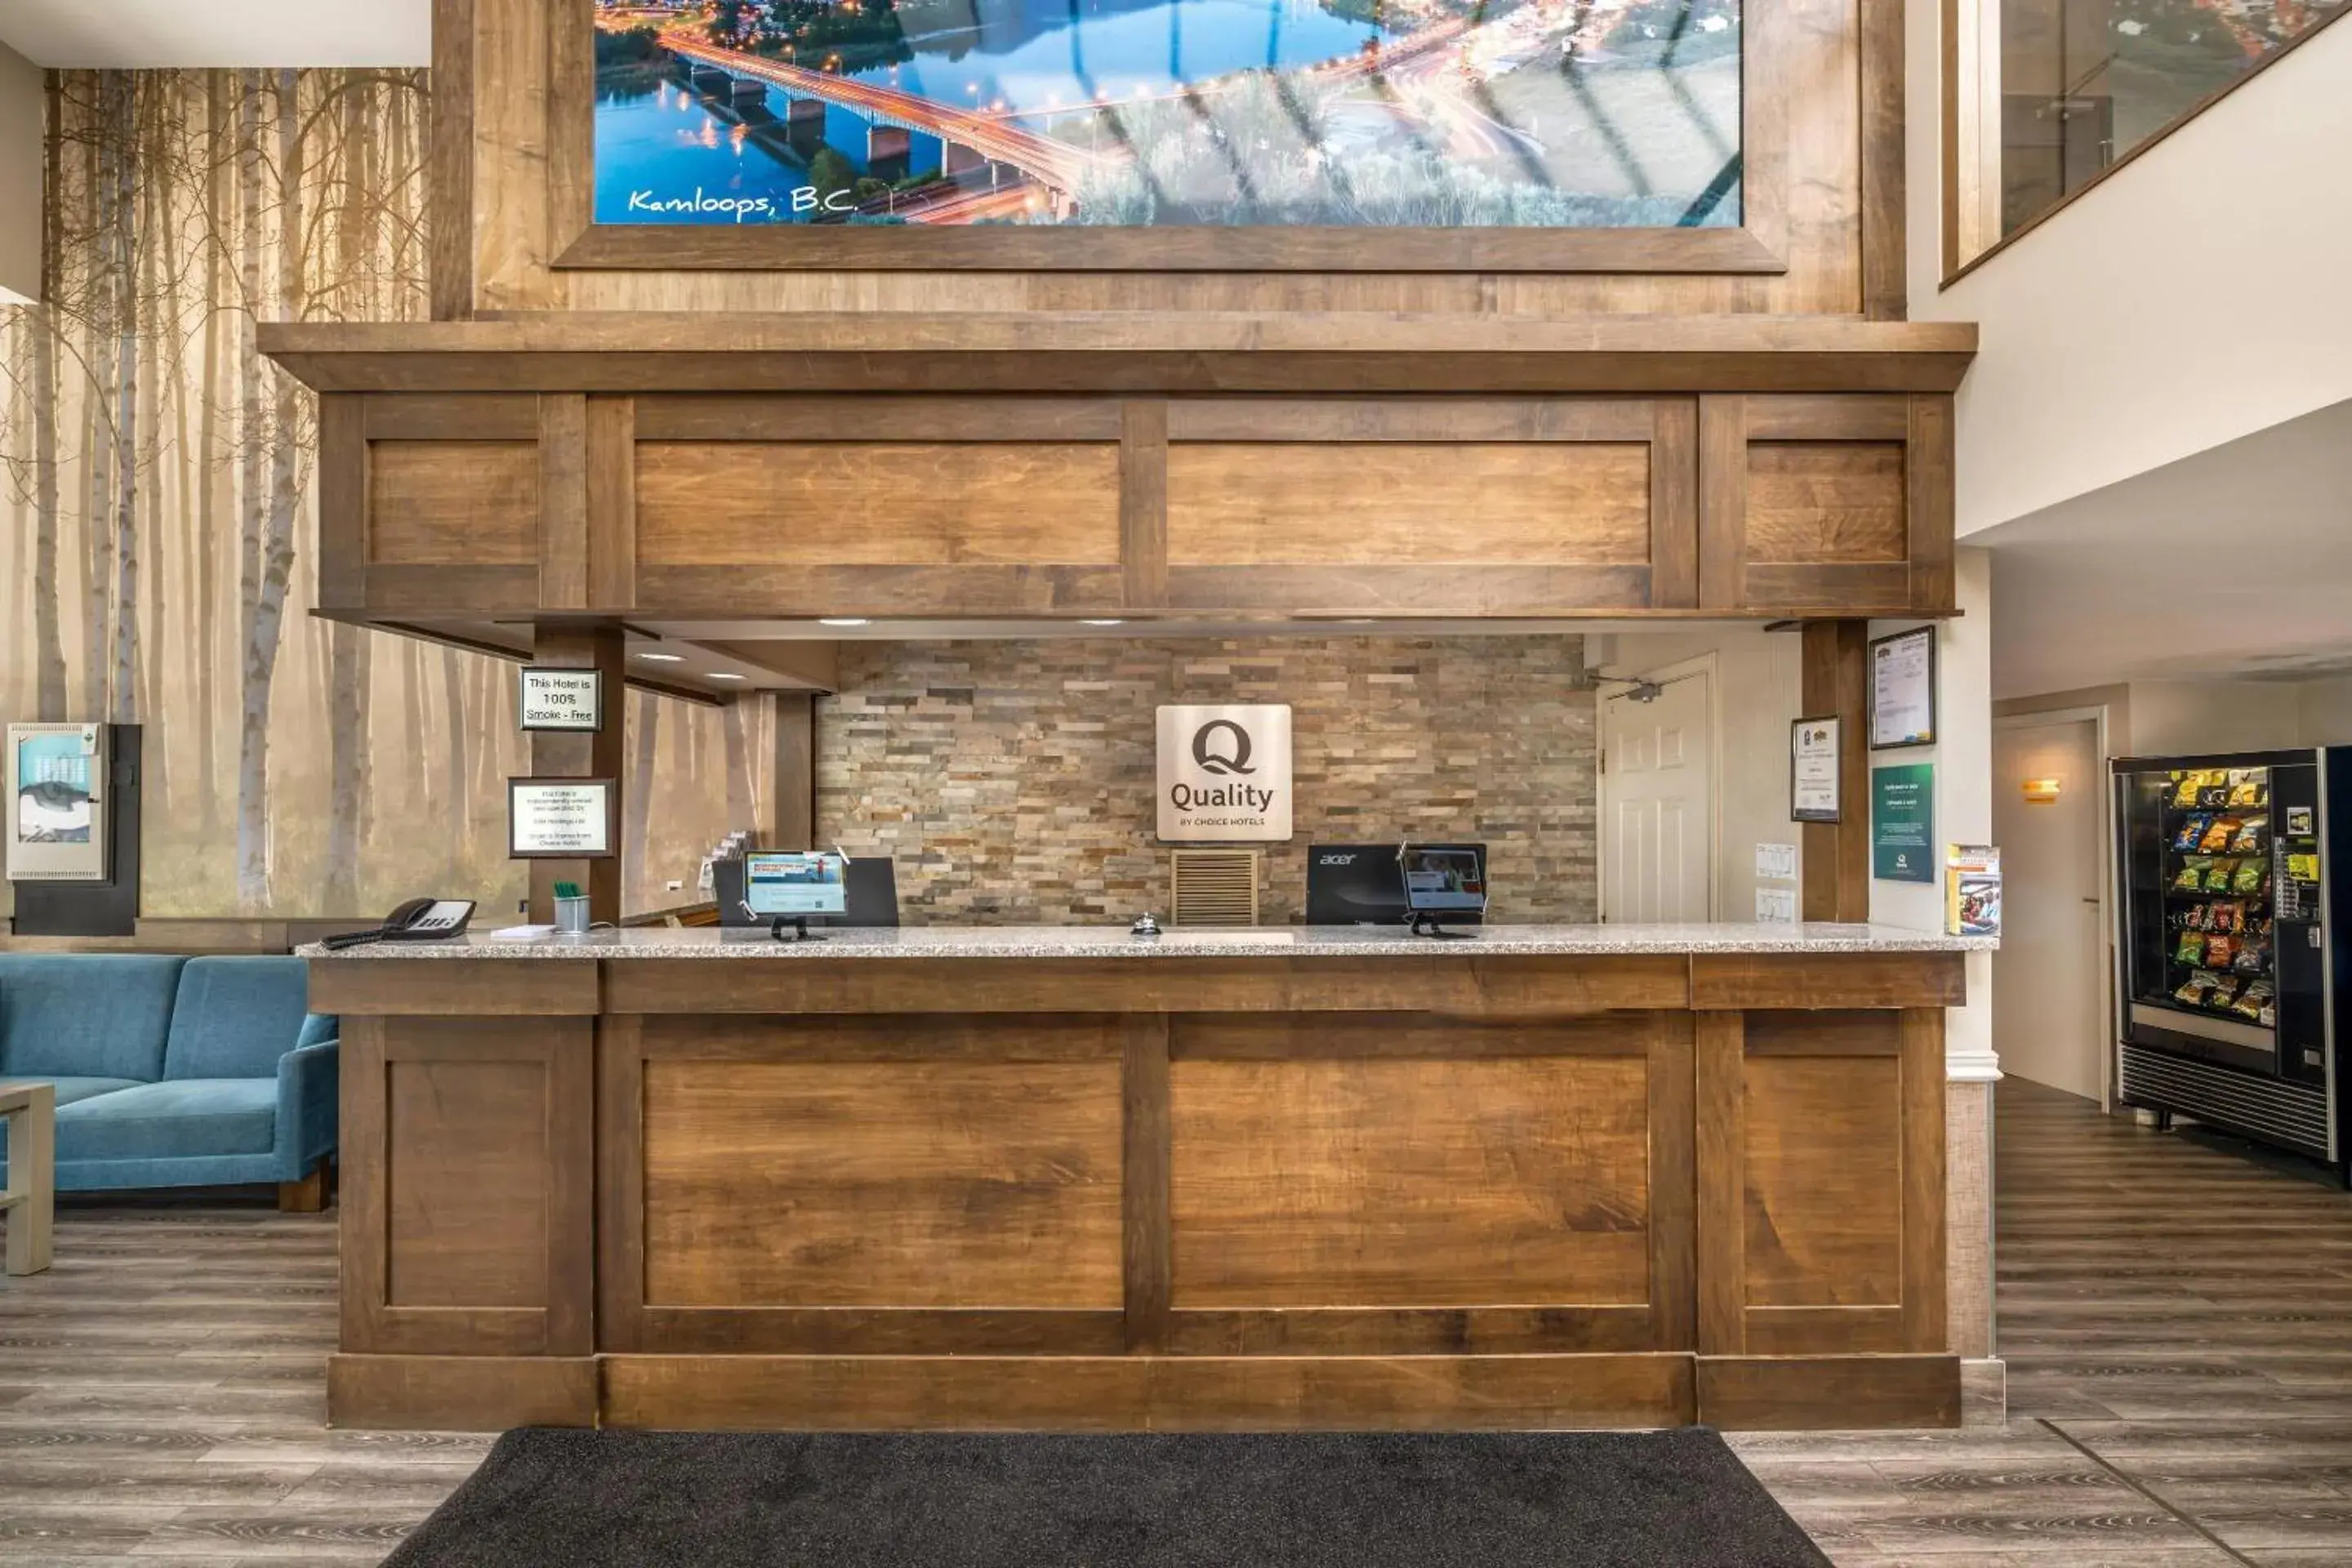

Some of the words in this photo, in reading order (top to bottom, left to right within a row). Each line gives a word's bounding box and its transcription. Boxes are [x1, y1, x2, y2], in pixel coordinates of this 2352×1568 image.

[628, 186, 776, 223] Kamloops,
[790, 185, 858, 211] B.C.
[529, 678, 550, 688] This
[553, 679, 579, 689] Hotel
[581, 679, 590, 689] is
[543, 693, 577, 705] 100%
[527, 710, 561, 719] Smoke
[571, 710, 592, 721] Free
[1192, 719, 1257, 775] Q
[1170, 783, 1274, 813] Quality
[1180, 817, 1192, 826] BY
[1194, 817, 1228, 826] CHOICE
[1230, 817, 1265, 826] HOTELS
[1320, 854, 1356, 865] acer
